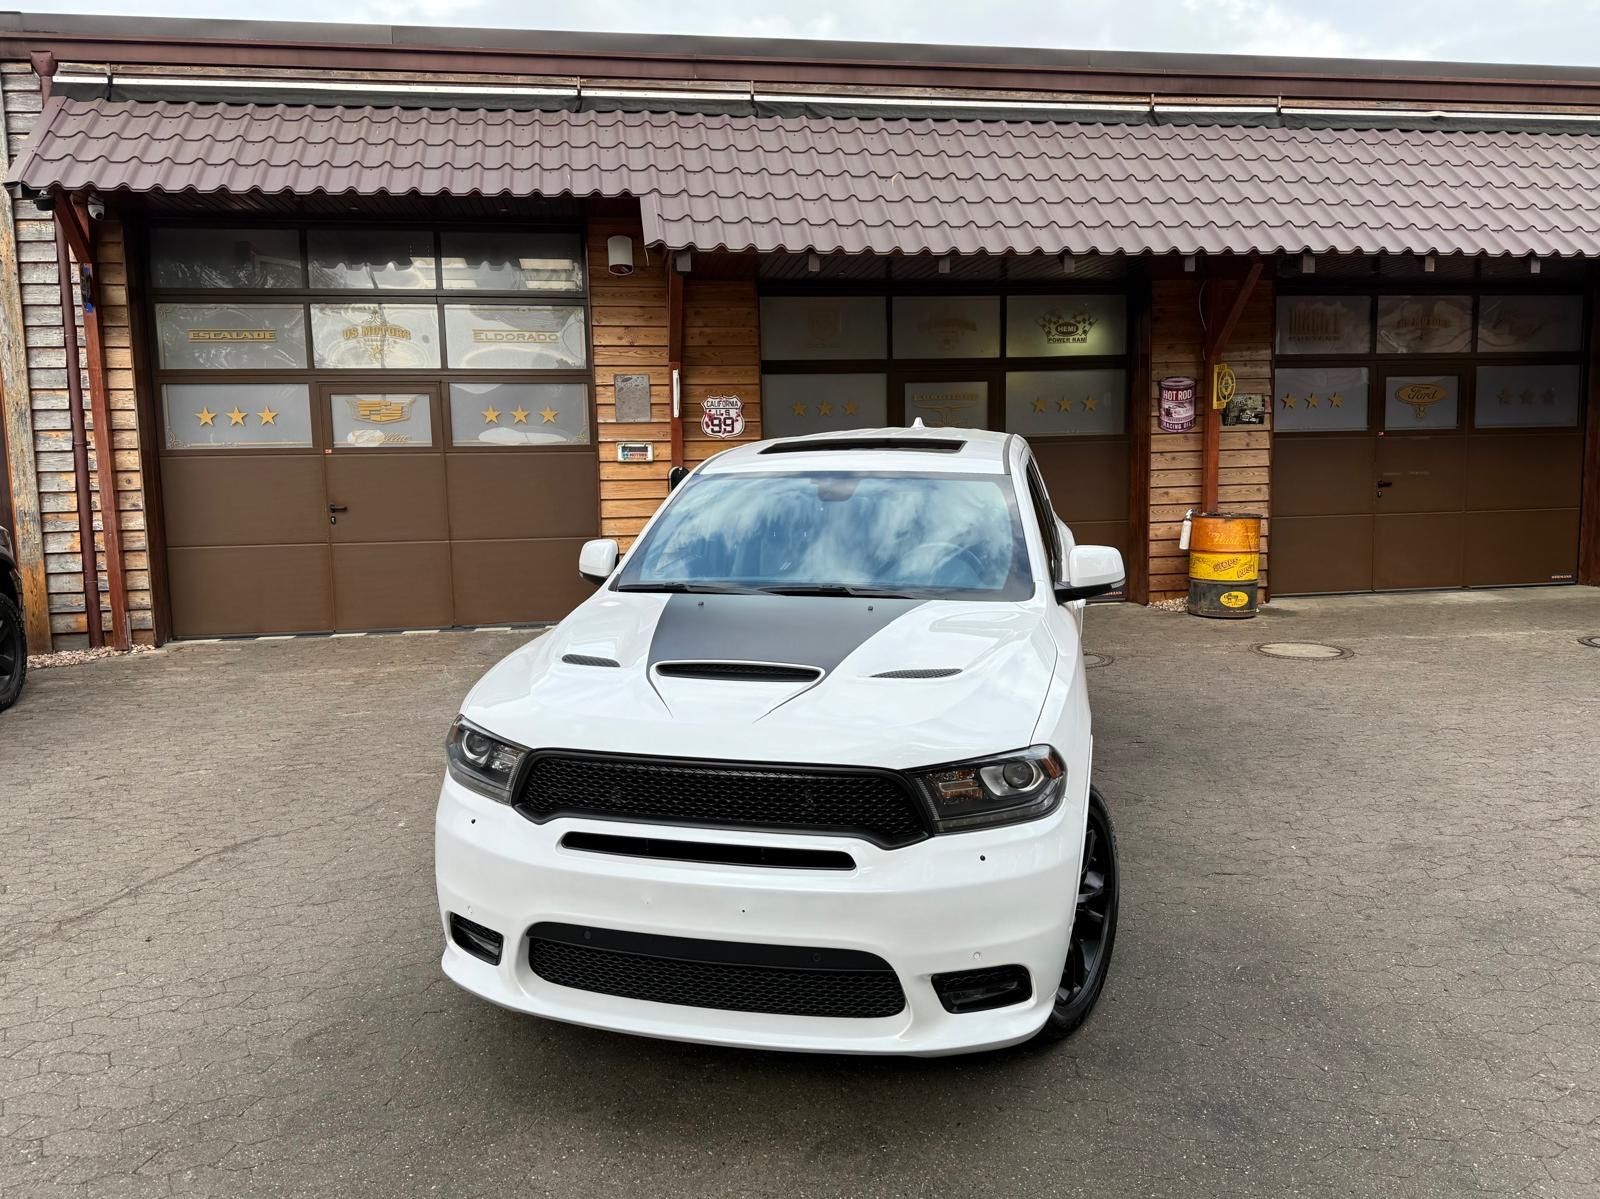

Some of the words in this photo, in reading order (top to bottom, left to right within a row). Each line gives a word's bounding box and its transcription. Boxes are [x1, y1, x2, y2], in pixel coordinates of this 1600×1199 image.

[187, 330, 276, 340] ESCALADE
[472, 331, 560, 342] ELDORADO
[1163, 390, 1177, 401] HOT
[1177, 389, 1192, 401] ROD
[1407, 385, 1438, 400] Ford
[706, 400, 739, 408] CALIFORNIA
[711, 417, 735, 434] 99
[1183, 421, 1192, 429] OIL
